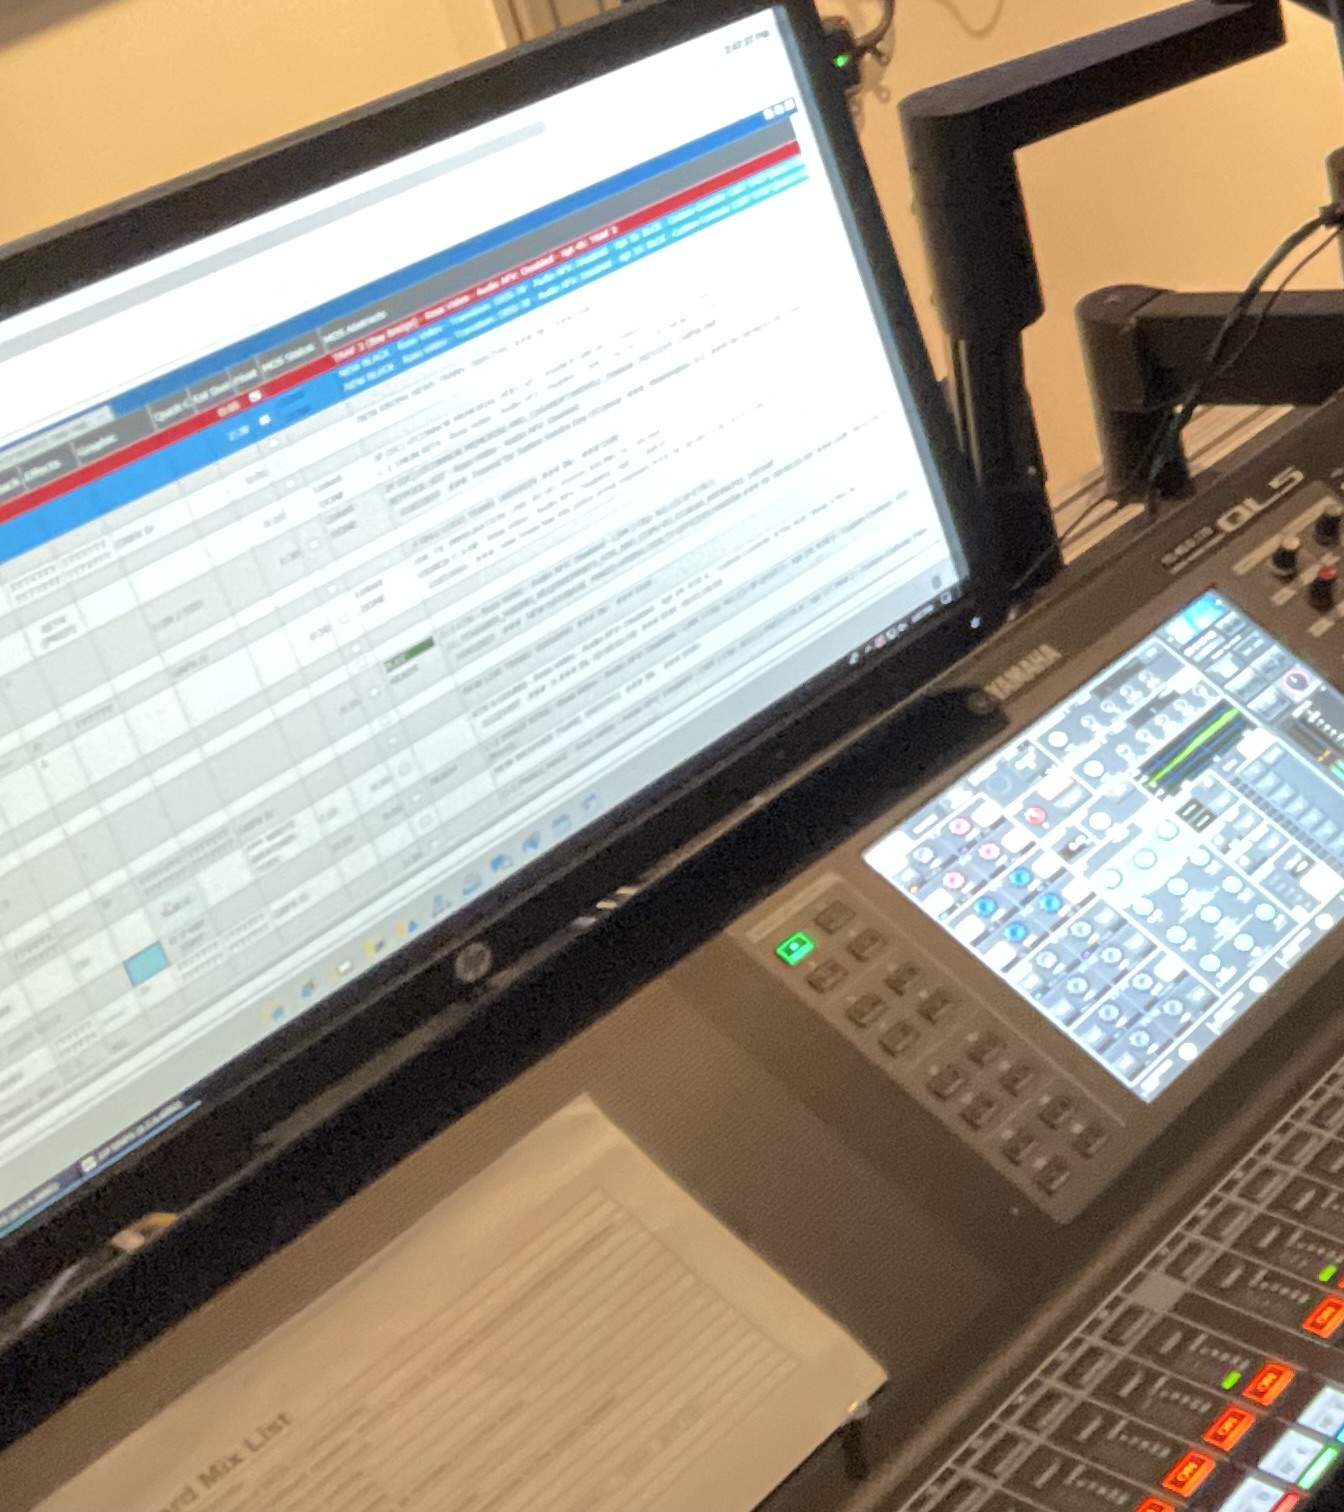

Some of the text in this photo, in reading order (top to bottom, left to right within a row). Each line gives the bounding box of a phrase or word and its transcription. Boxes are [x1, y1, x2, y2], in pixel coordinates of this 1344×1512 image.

[985, 644, 1063, 701] YAMAHA
[197, 1450, 244, 1491] Mix
[243, 1412, 293, 1454] List
